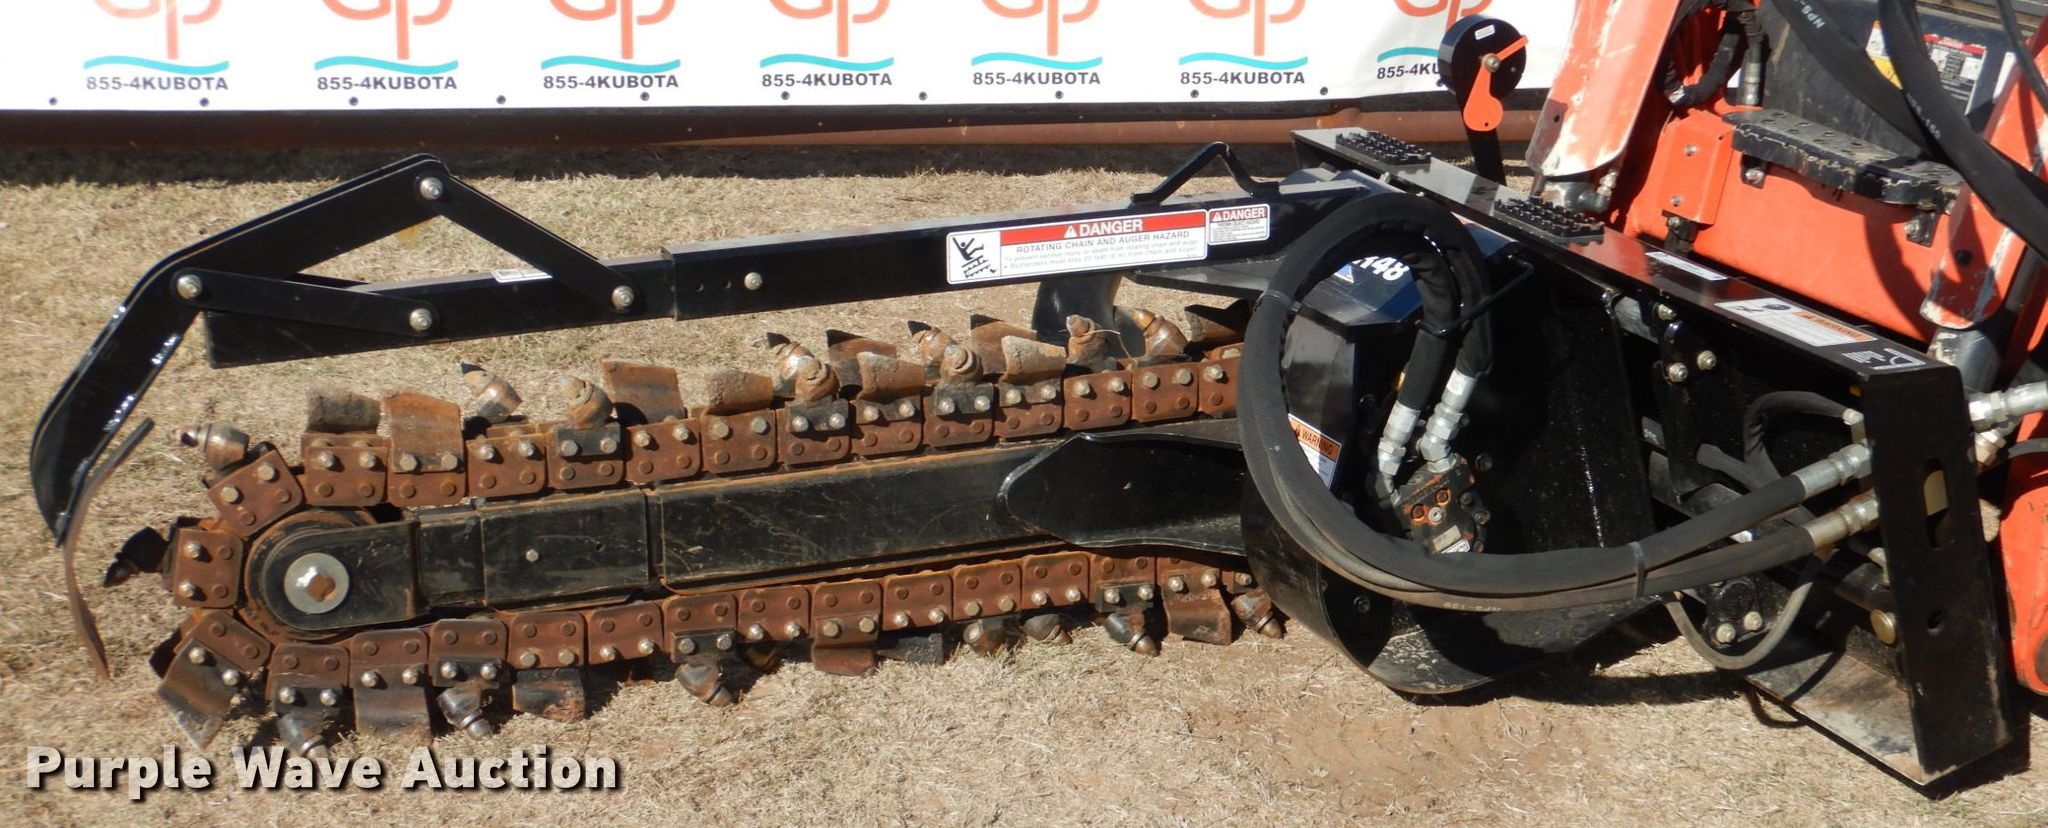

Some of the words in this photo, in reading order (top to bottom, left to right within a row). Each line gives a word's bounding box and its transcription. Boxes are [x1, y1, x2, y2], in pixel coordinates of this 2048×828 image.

[86, 76, 229, 91] 855-4KUBOTA
[317, 76, 457, 90] 855-4KUBOTA
[543, 74, 679, 89] 855-4KUBOTA
[762, 72, 892, 87] 855-4KUBOTA
[973, 72, 1101, 85] 855-4KUBOTA
[1180, 71, 1305, 85] 855-4KUBOTA
[1222, 207, 1265, 221] DANGER
[1079, 218, 1144, 237] DANGER
[1016, 243, 1062, 253] ROTATING
[1065, 239, 1094, 249] CHAIN
[1097, 237, 1116, 246] AND
[1118, 234, 1150, 243] AUGER
[1153, 230, 1190, 240] HAZARD
[1352, 255, 1410, 281] 148
